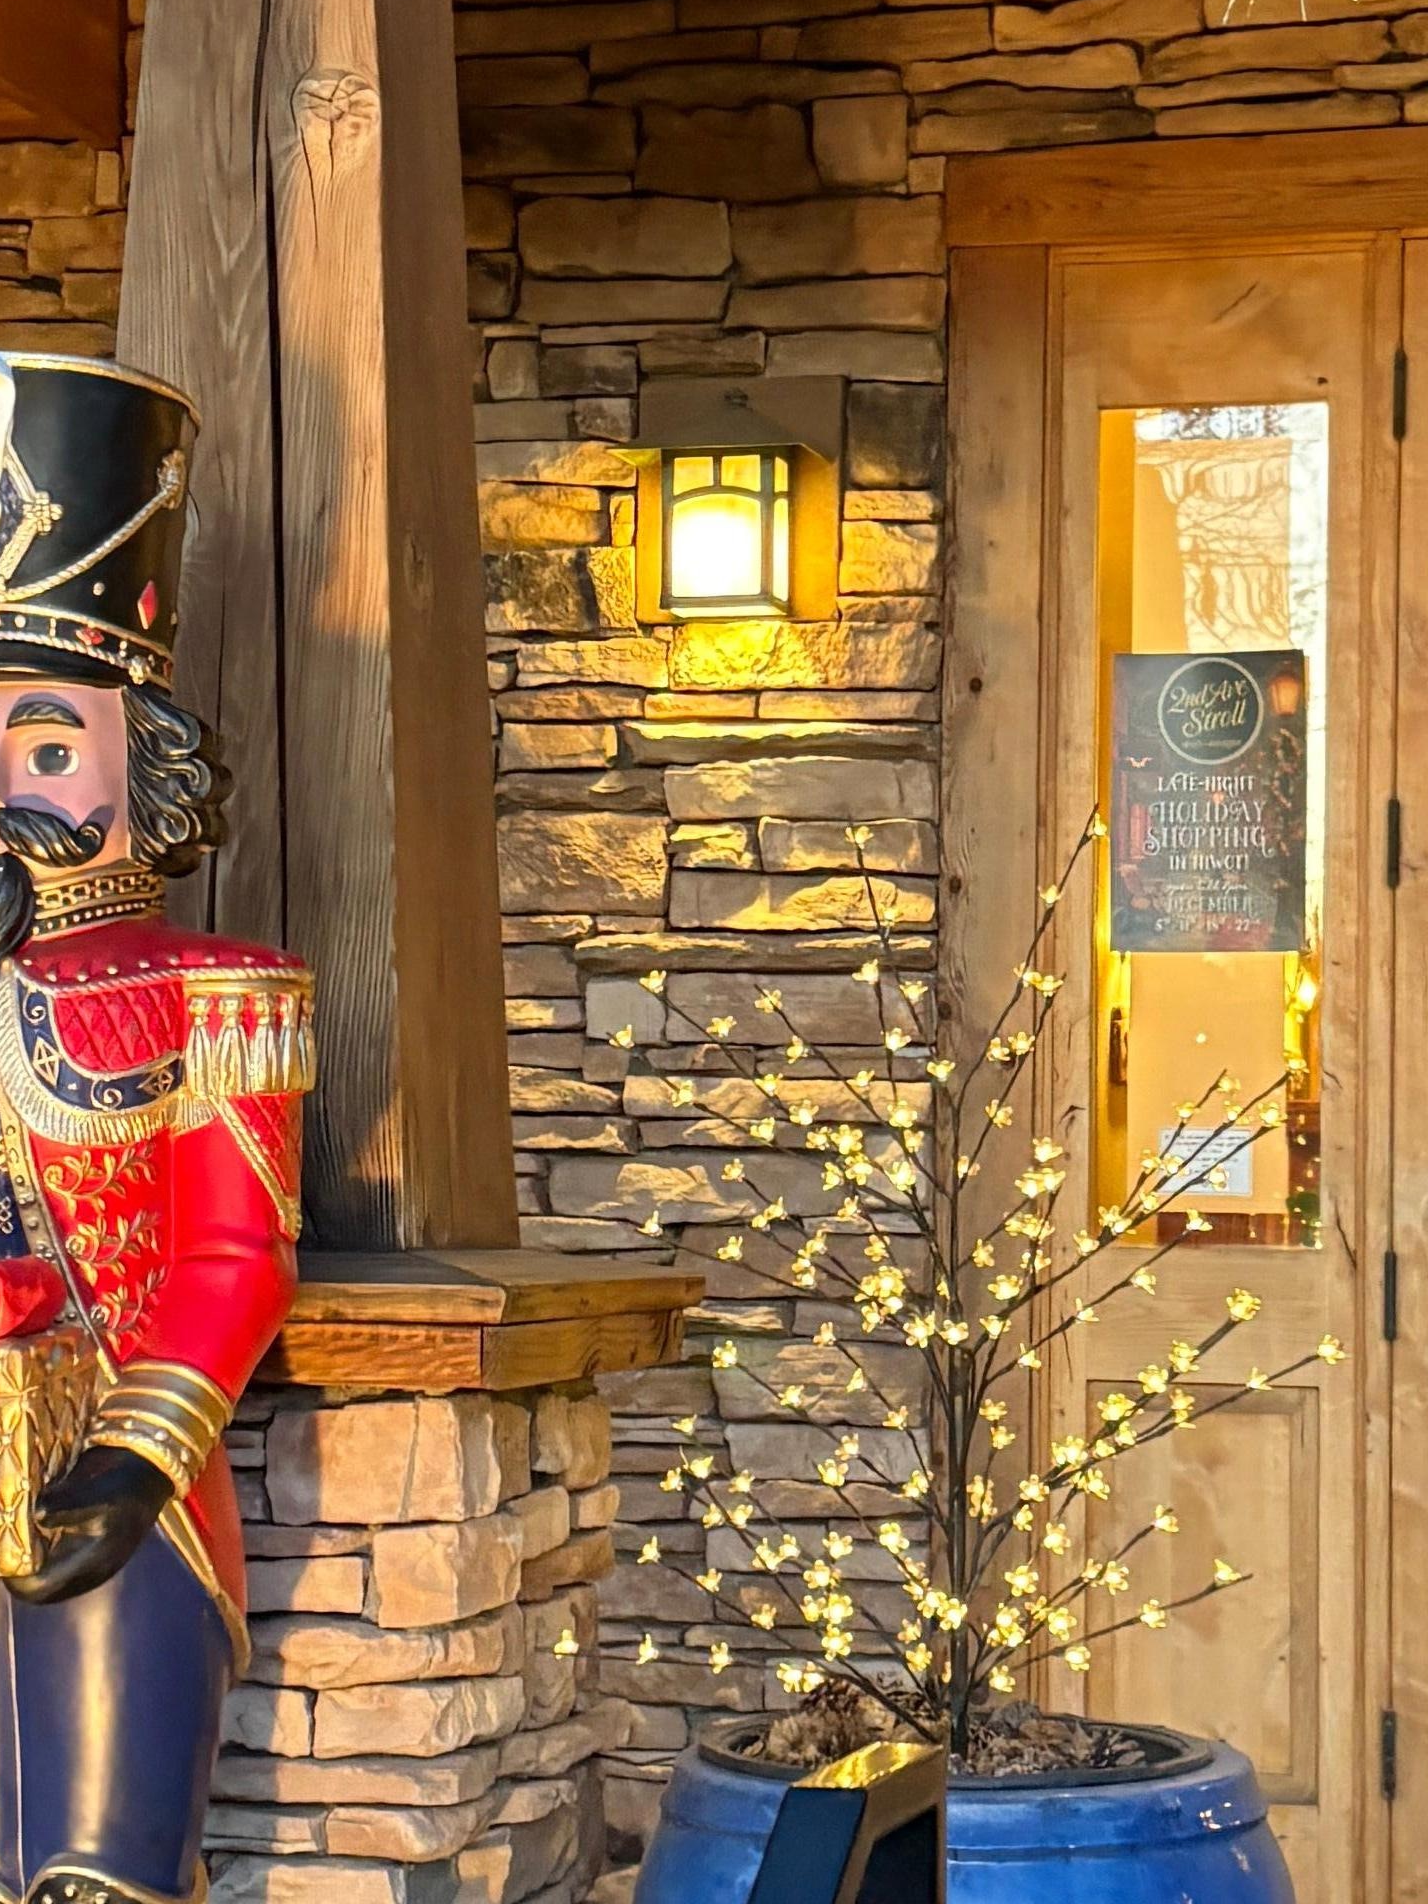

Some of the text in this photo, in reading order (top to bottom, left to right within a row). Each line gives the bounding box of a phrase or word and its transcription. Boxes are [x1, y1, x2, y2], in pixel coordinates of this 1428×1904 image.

[1167, 683, 1210, 713] 2nd
[1182, 698, 1247, 737] Stroll
[1157, 771, 1256, 797] LATE-NIGHT
[1148, 799, 1266, 824] HOLIDAY
[1143, 825, 1275, 857] SHOPPING
[1169, 853, 1187, 871] IN
